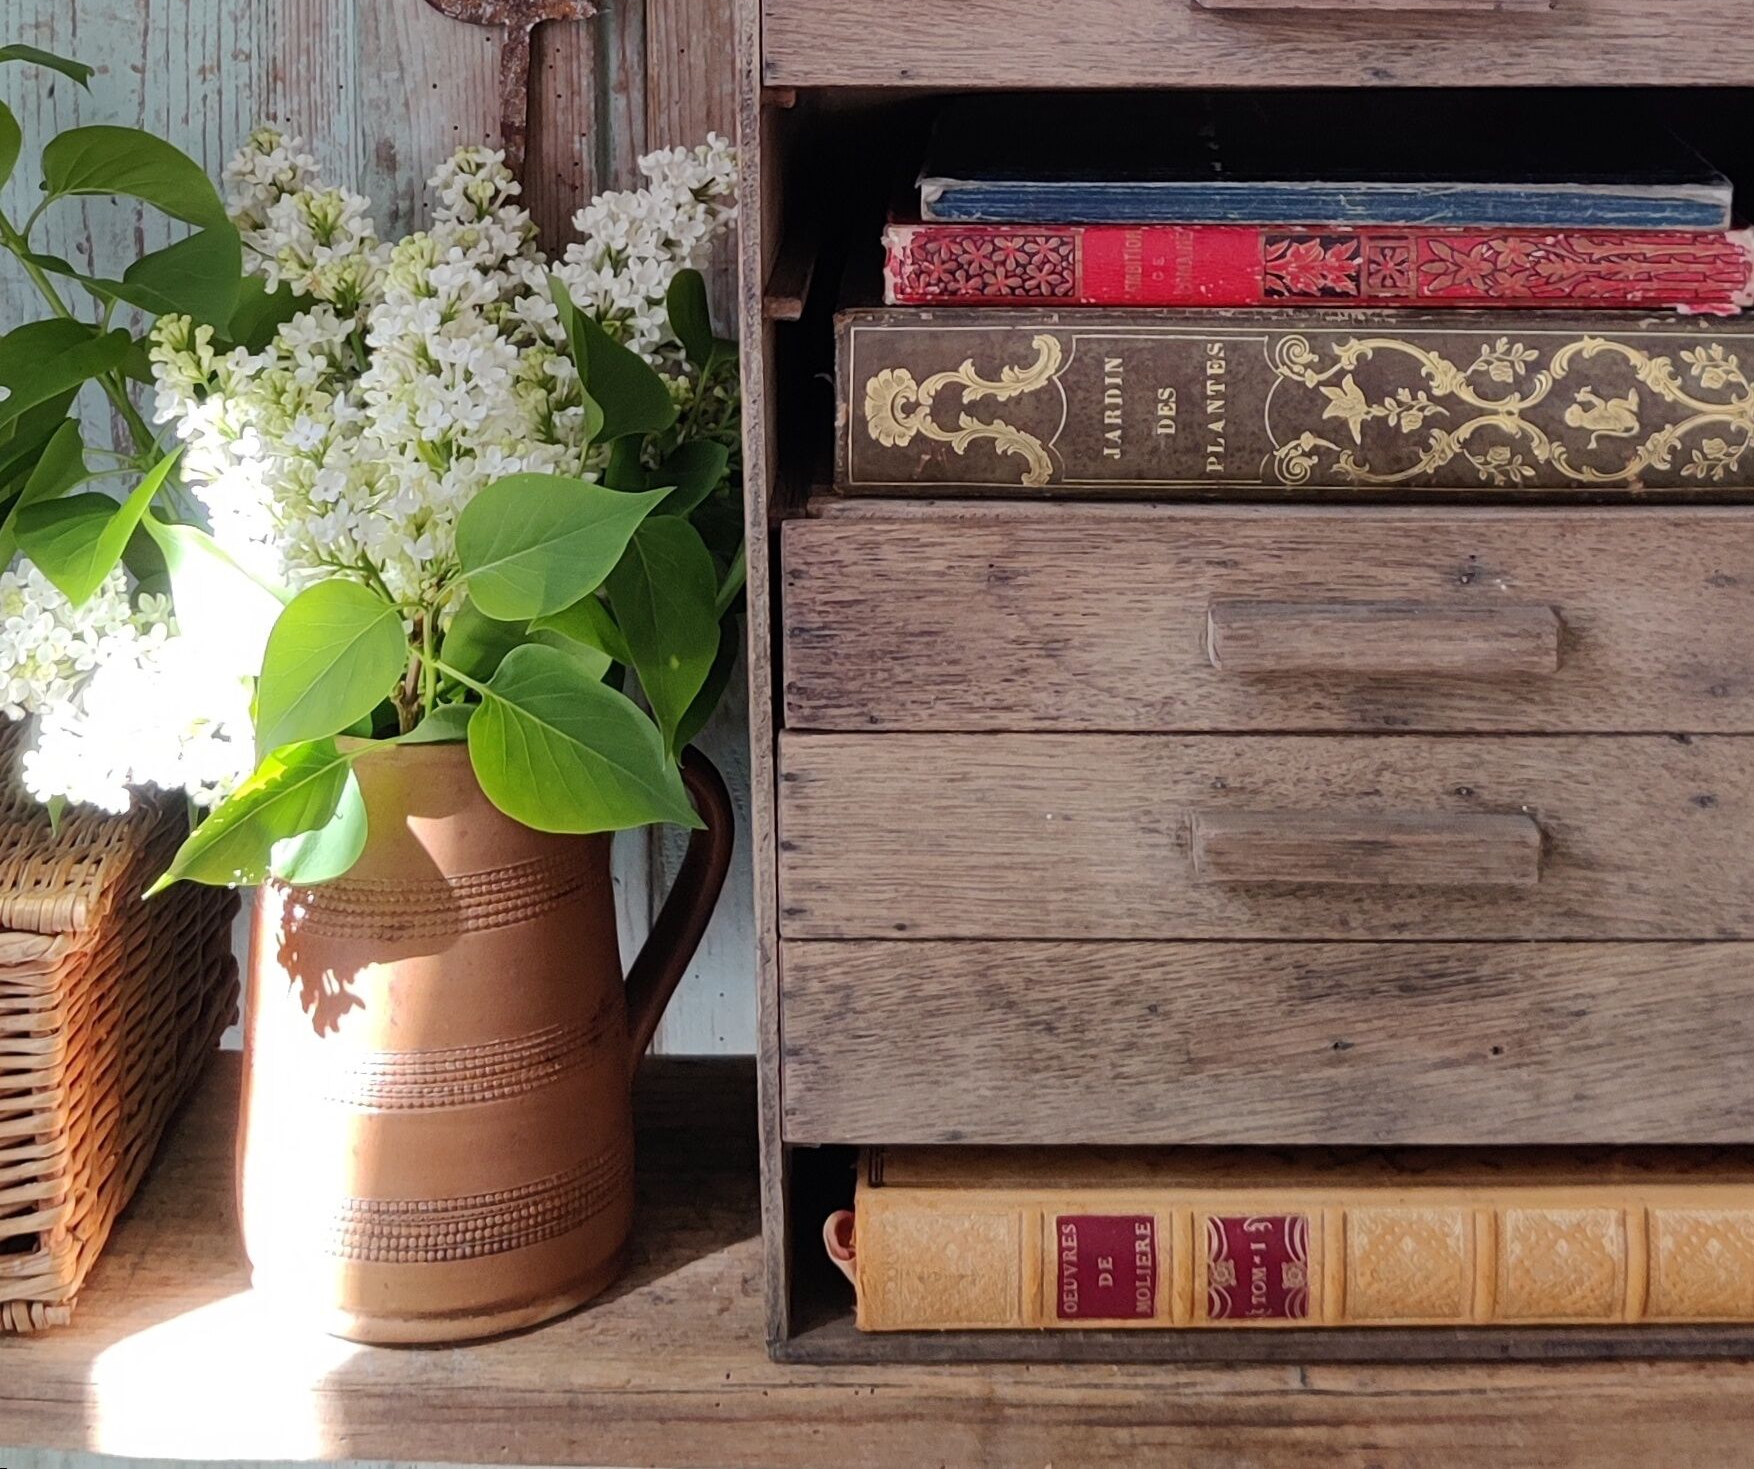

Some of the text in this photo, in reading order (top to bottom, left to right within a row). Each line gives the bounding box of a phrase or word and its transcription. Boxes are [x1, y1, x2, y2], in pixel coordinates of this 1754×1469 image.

[1103, 358, 1124, 460] JARDIN
[1157, 387, 1177, 435] DES
[1206, 342, 1226, 472] PLANTES
[1062, 1223, 1077, 1313] OEUVRES
[1098, 1256, 1113, 1287] DE
[1135, 1221, 1152, 1314] MOLIERE
